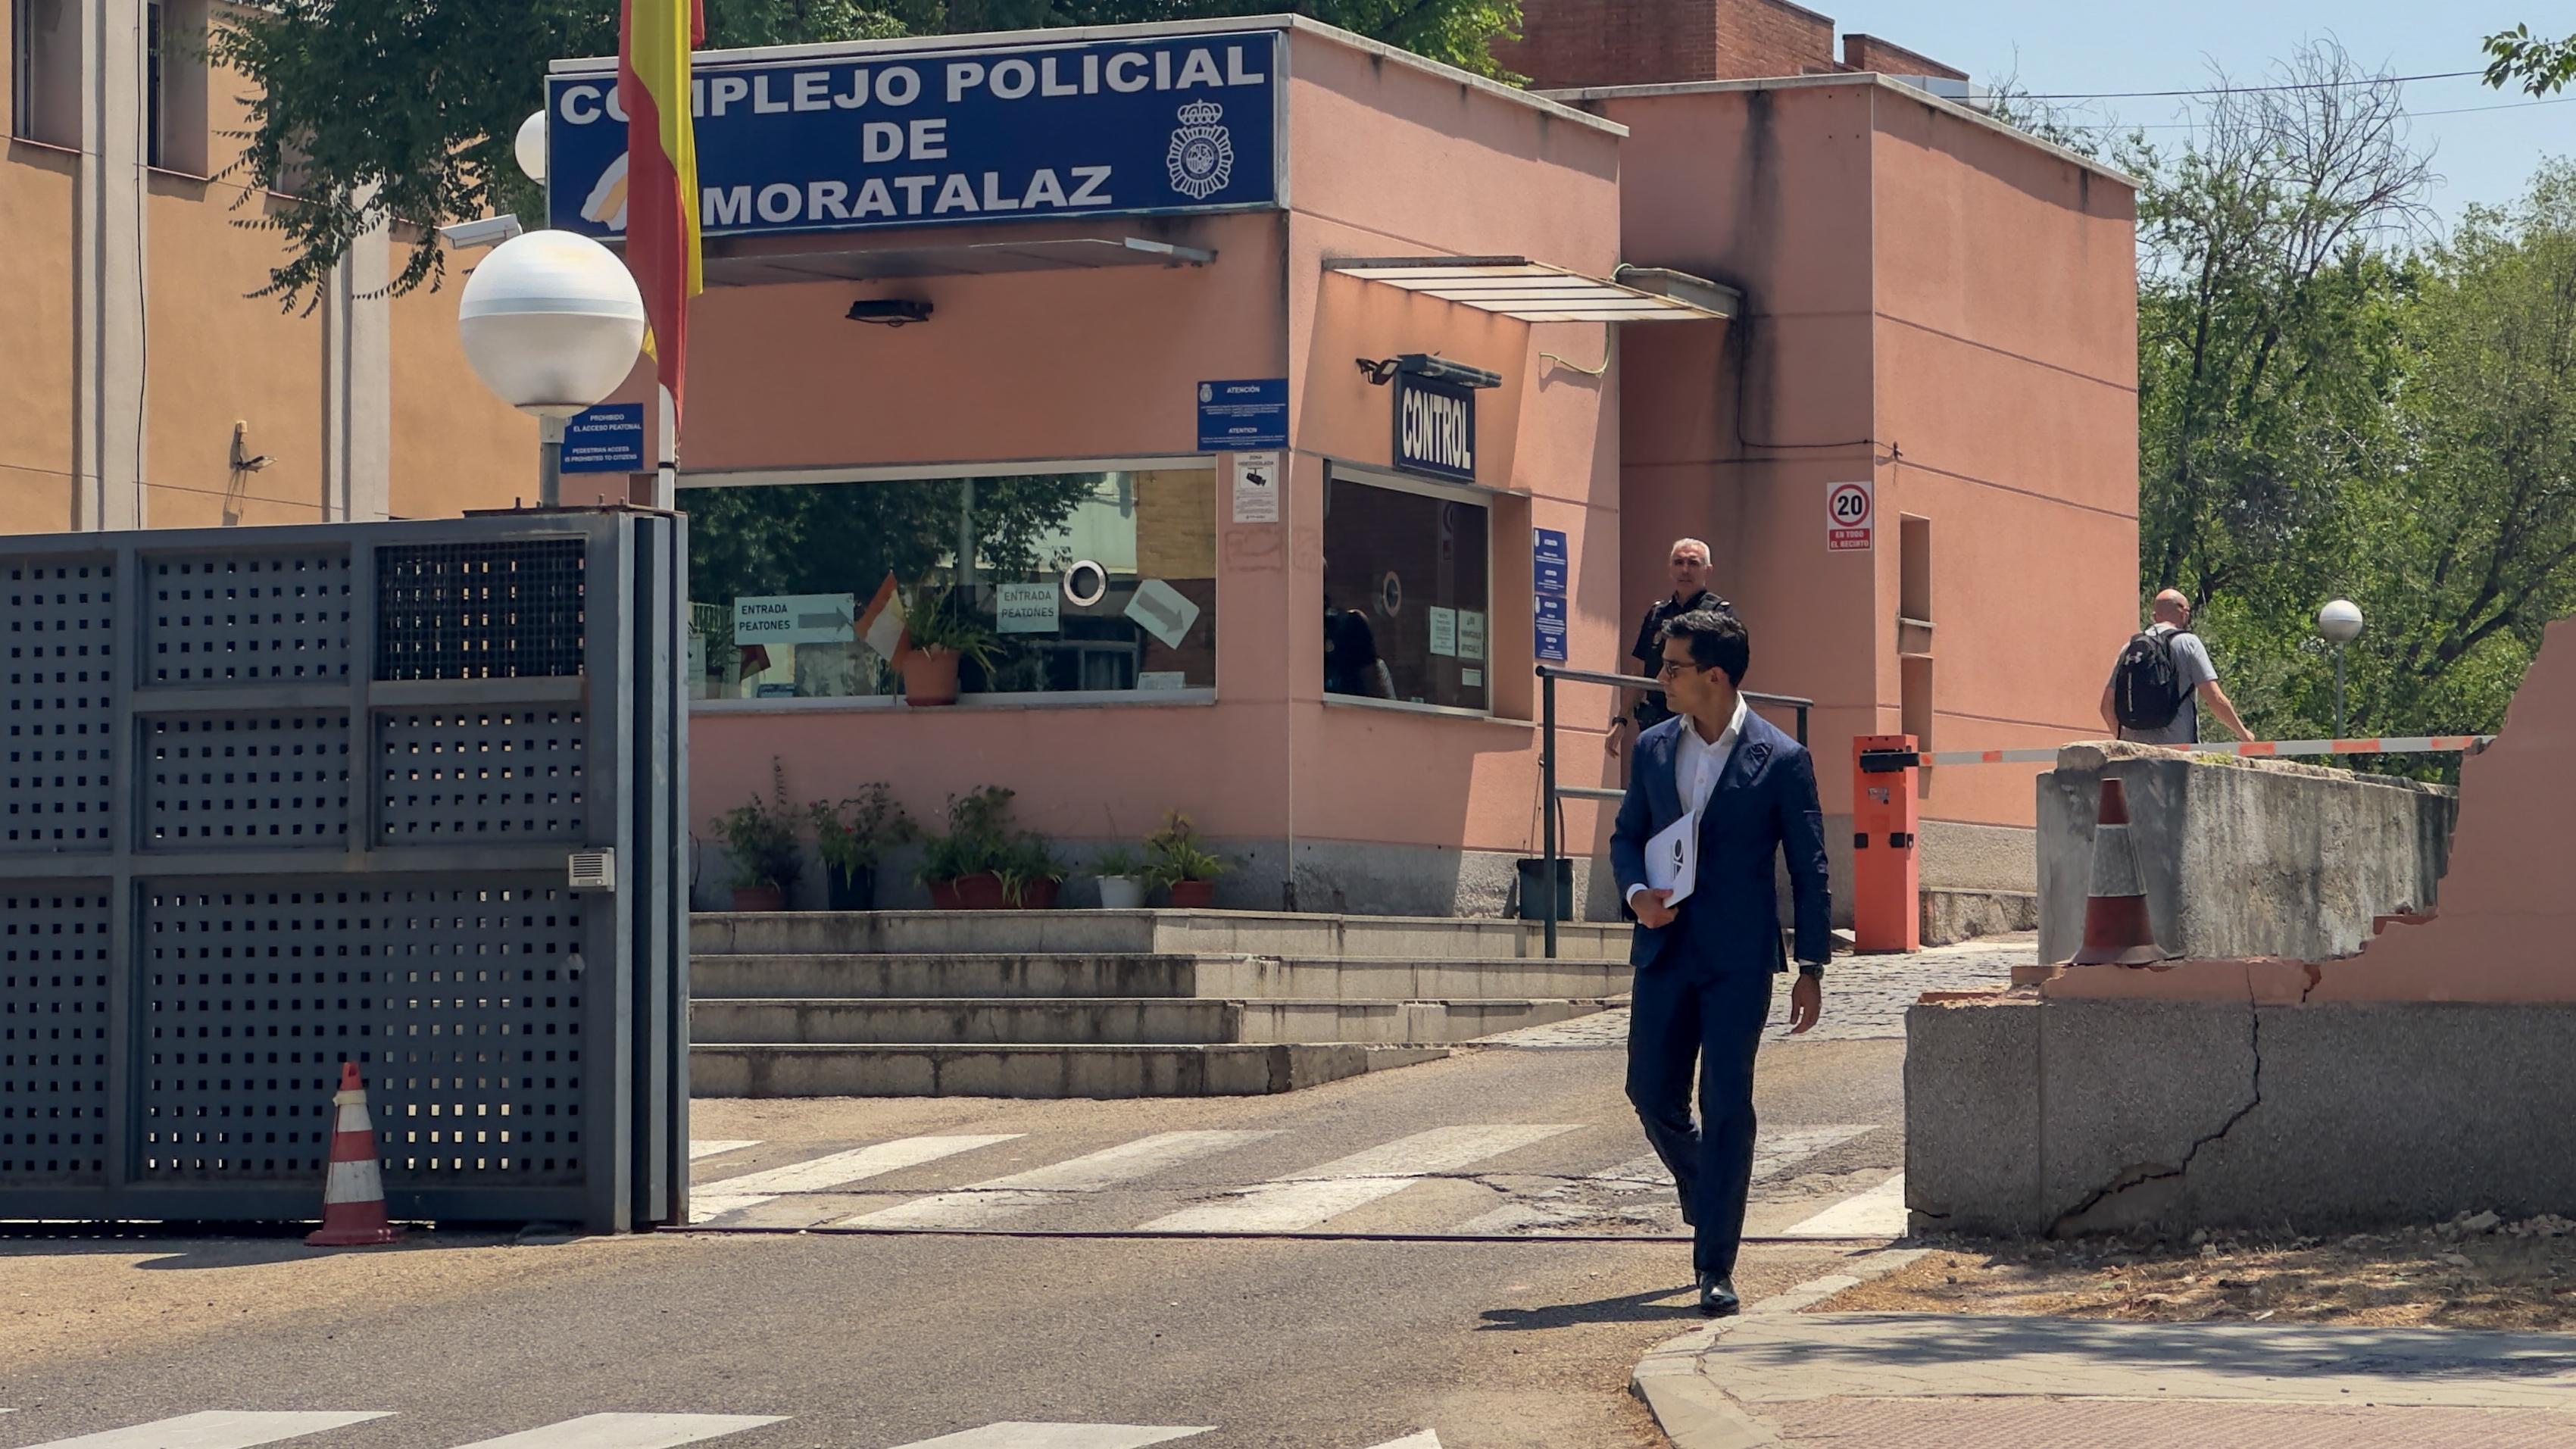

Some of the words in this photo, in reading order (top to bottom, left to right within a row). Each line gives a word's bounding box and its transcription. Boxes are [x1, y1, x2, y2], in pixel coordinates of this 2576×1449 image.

[560, 67, 921, 125] CPLEJO
[946, 46, 1265, 103] POLICIAL
[863, 118, 948, 163] DE
[702, 165, 1112, 226] MORATALAZ
[1402, 387, 1471, 470] CONTROL
[1838, 495, 1863, 516] 20
[1004, 590, 1052, 602] ENTRADA
[741, 604, 788, 615] ENTRADA
[1001, 607, 1054, 619] PEATONES
[738, 620, 791, 632] PEATONES
